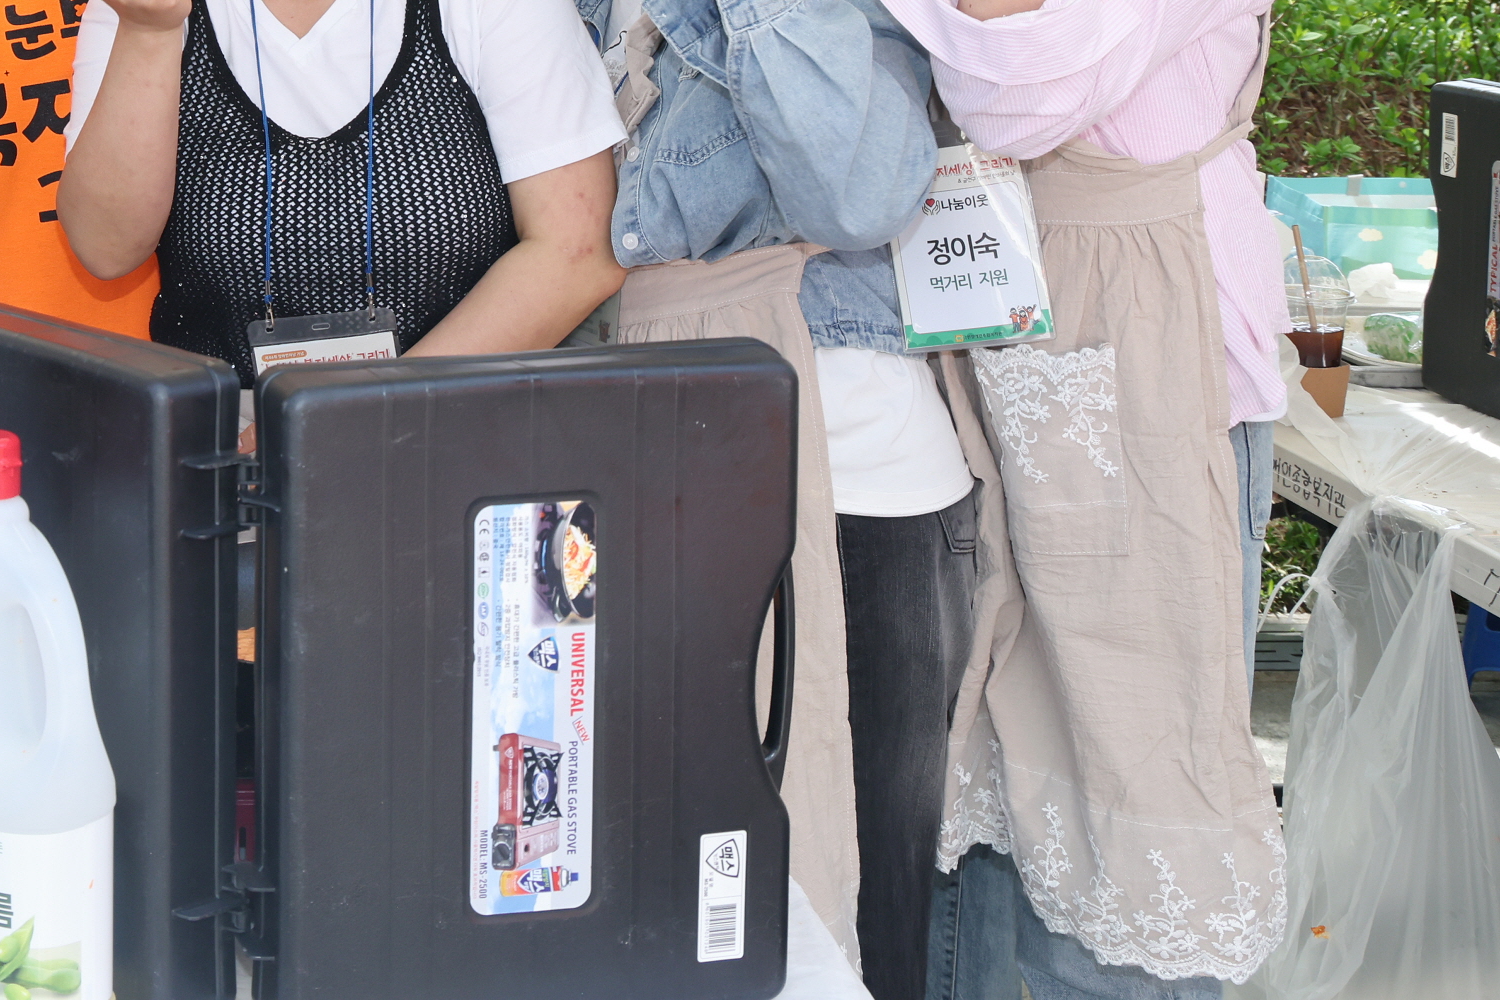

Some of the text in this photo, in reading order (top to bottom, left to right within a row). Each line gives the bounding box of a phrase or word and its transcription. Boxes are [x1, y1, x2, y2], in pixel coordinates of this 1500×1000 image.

[941, 193, 989, 211] 나눔이웃
[927, 232, 1000, 265] 정이숙
[930, 268, 1009, 292] 먹거리 지원
[538, 640, 556, 668] 맥스
[570, 632, 586, 717] UNIVERSAL
[574, 720, 590, 742] NEW
[567, 741, 578, 855] PORTABLE GAS STOVE
[479, 830, 488, 899] MODEL: MS-2500
[719, 847, 735, 871] 맥스
[529, 869, 545, 893] 맥스
